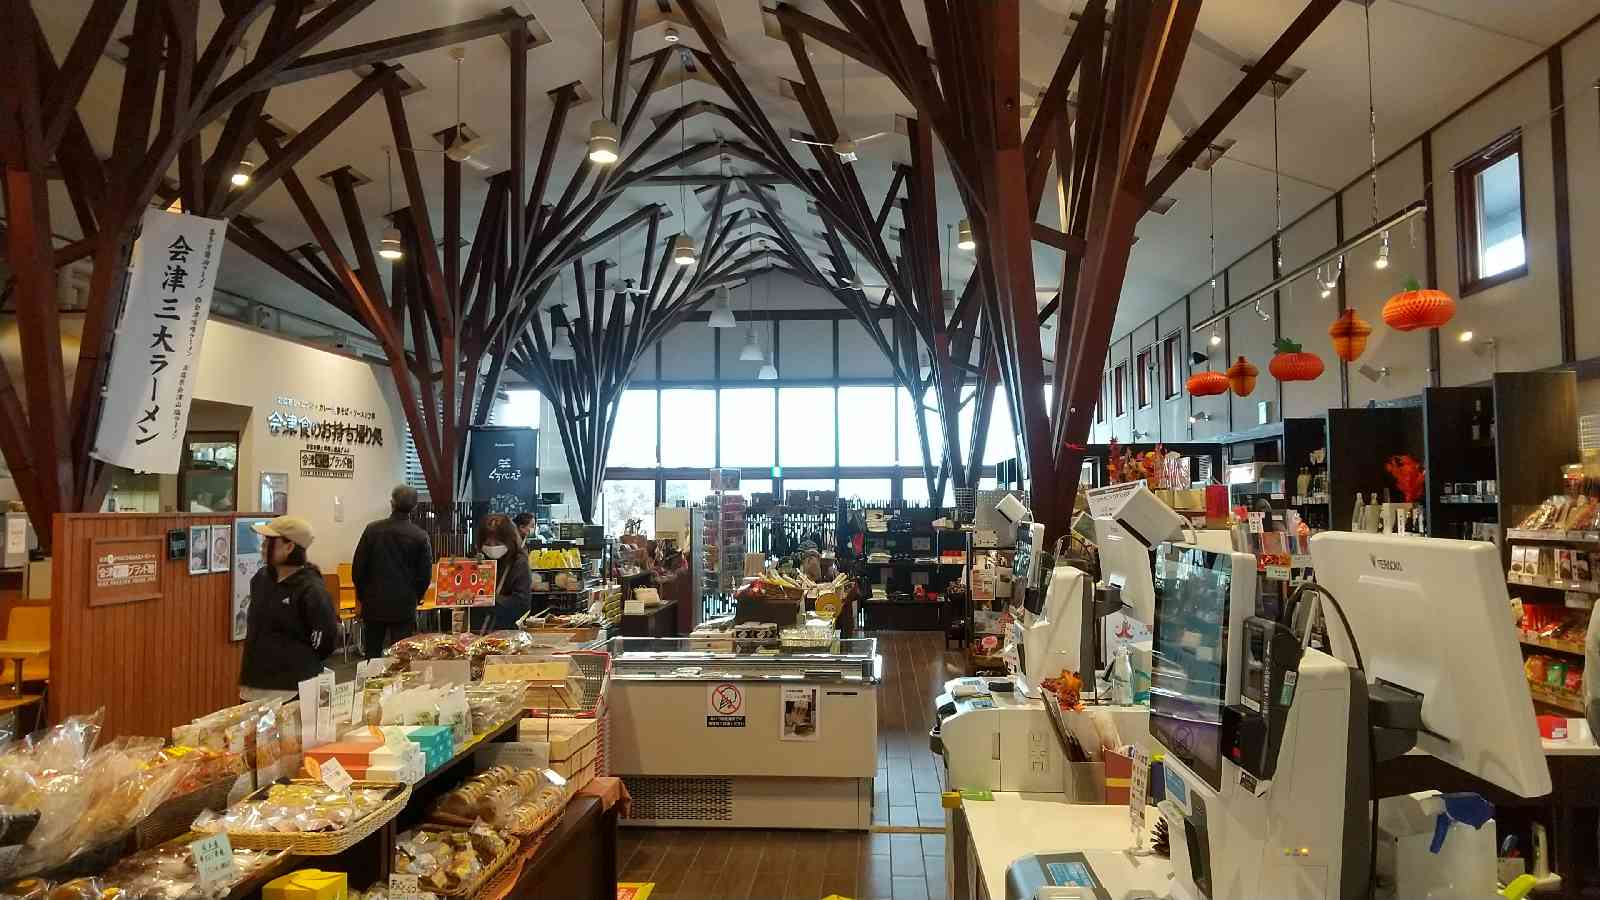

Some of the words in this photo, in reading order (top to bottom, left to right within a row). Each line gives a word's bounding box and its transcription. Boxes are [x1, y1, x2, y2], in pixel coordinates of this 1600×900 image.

[135, 234, 194, 447] 会津三大ラーメン
[268, 410, 383, 446] 会津食のお持ち帰り処
